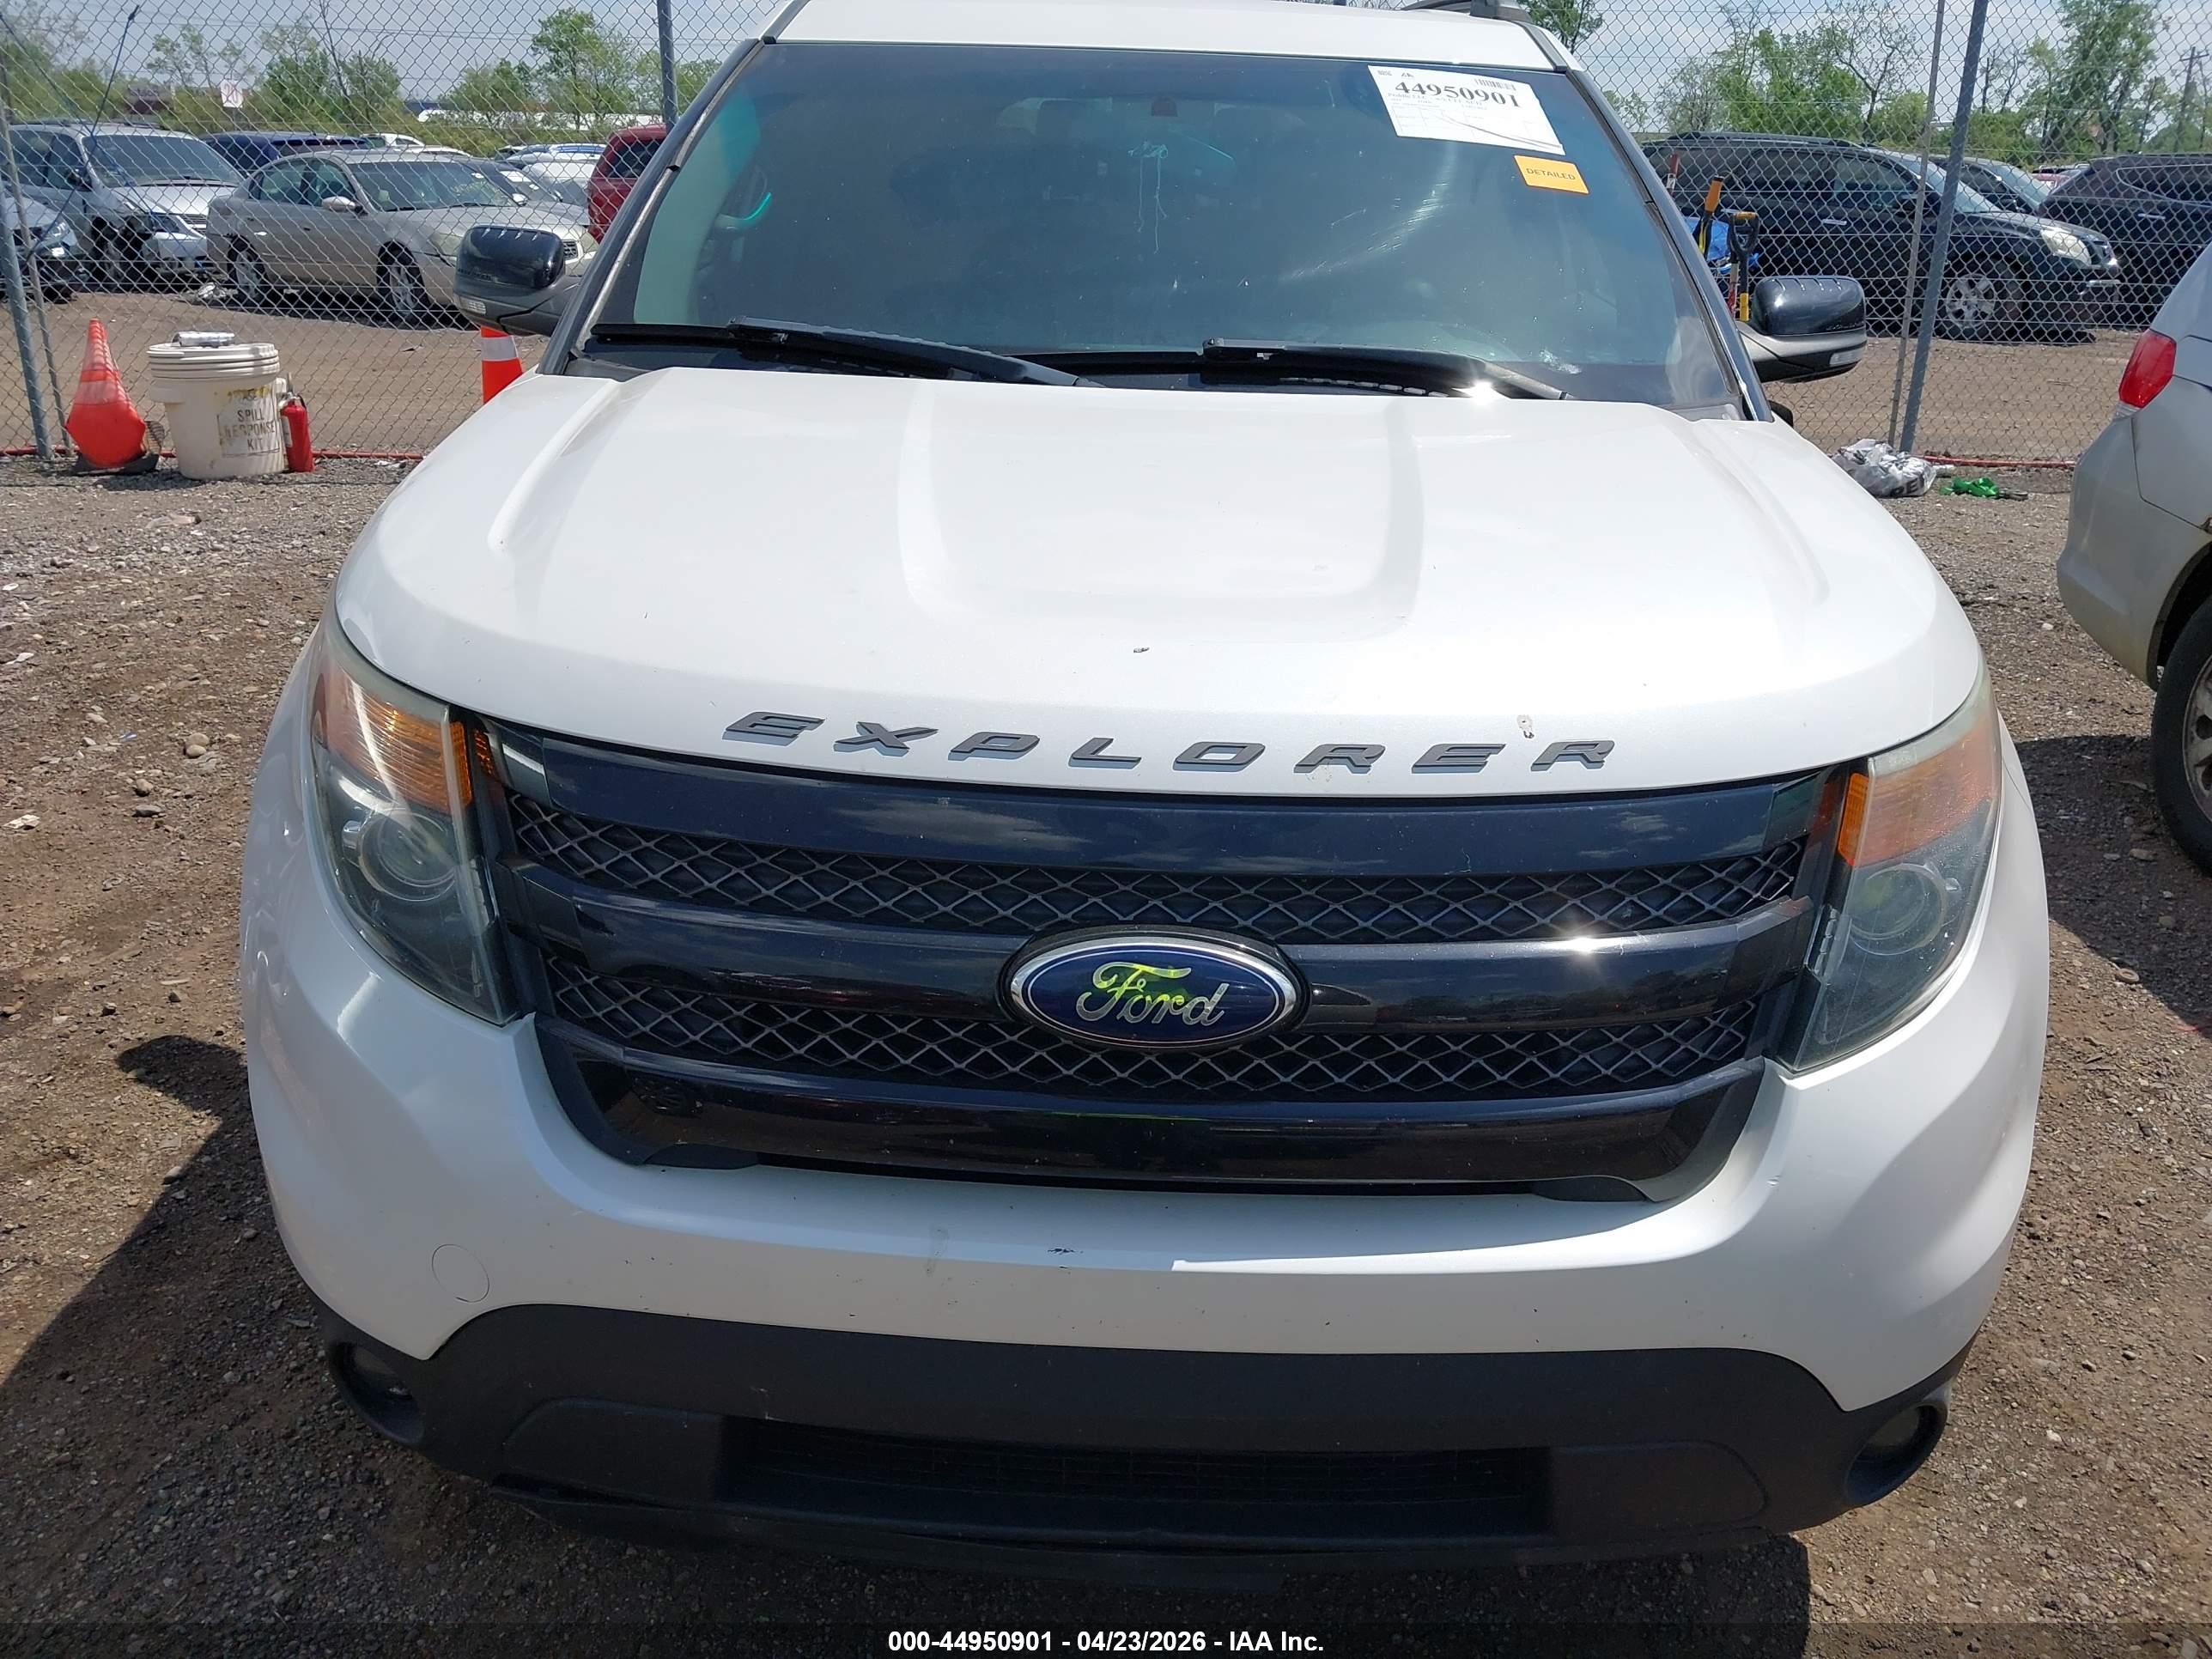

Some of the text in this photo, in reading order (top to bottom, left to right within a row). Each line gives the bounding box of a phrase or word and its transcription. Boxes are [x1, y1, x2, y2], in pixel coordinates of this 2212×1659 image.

[1395, 82, 1521, 107] 44950901
[1526, 167, 1577, 180] DETAILED
[237, 408, 264, 422] SPILL
[247, 438, 263, 451] KIT
[724, 711, 1615, 771] EXPLORER
[1076, 961, 1231, 1026] Ford
